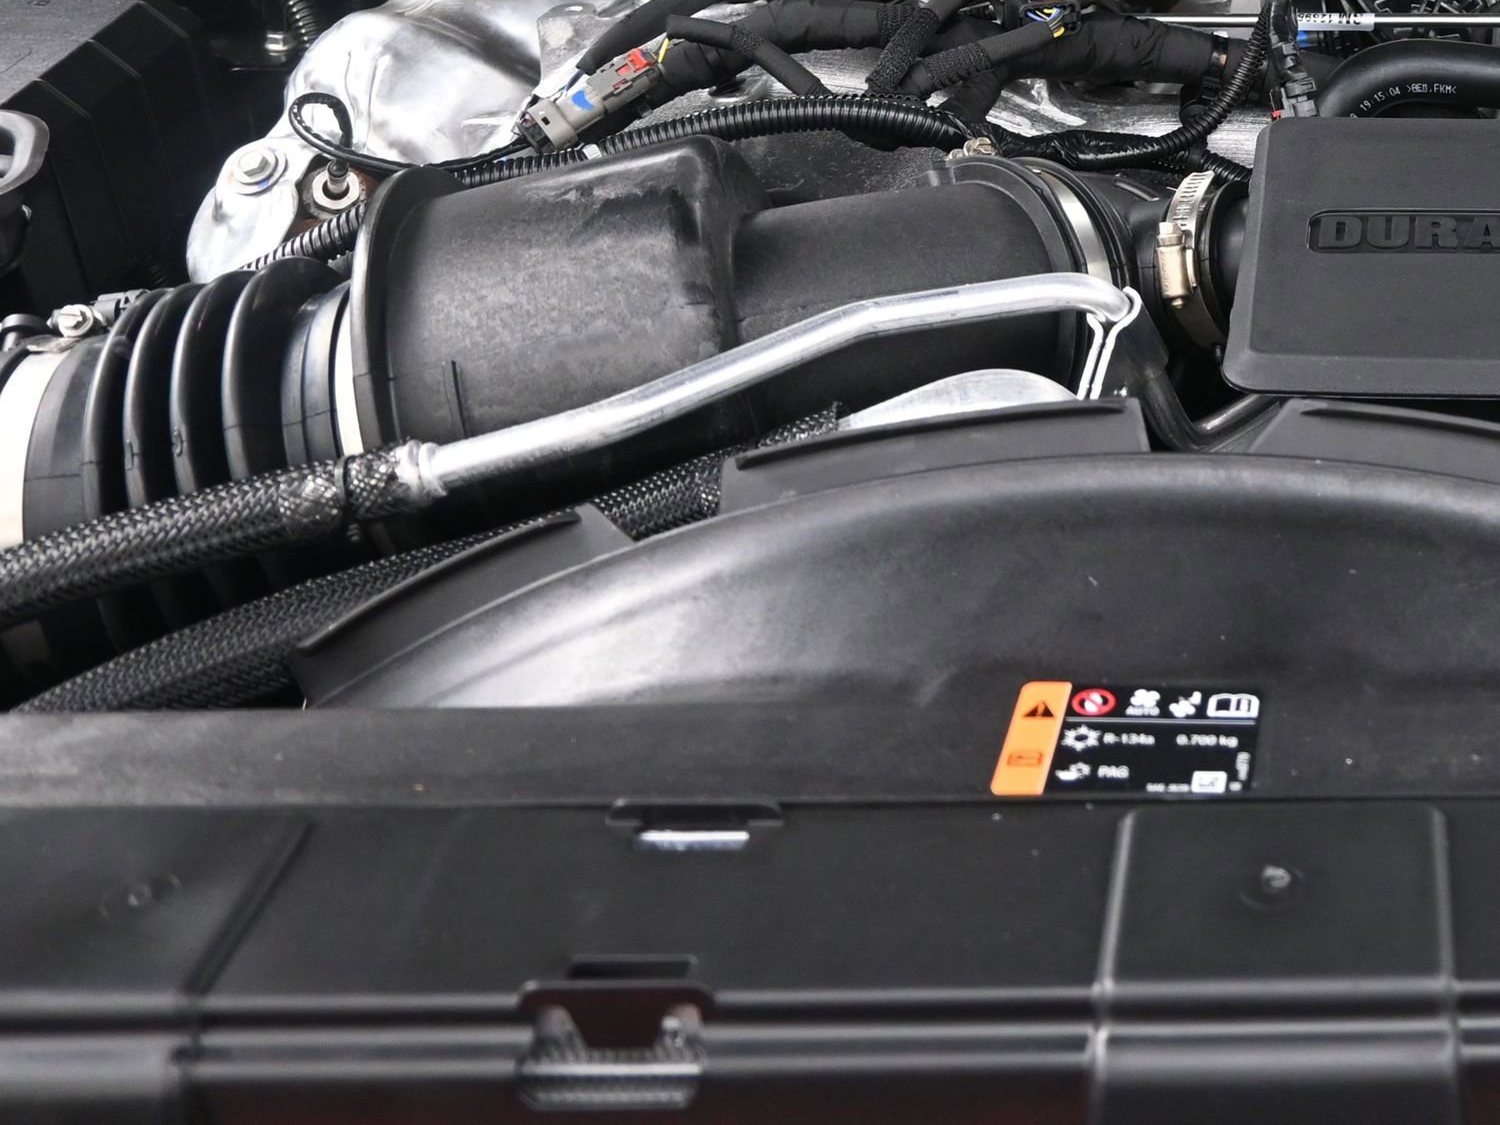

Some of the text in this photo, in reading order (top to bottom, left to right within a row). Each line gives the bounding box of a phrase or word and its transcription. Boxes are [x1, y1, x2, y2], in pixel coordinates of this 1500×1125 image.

[1125, 705, 1161, 717] AUTO
[1103, 733, 1156, 746] R-134a
[1218, 734, 1239, 748] kg
[1098, 765, 1130, 780] PAG
